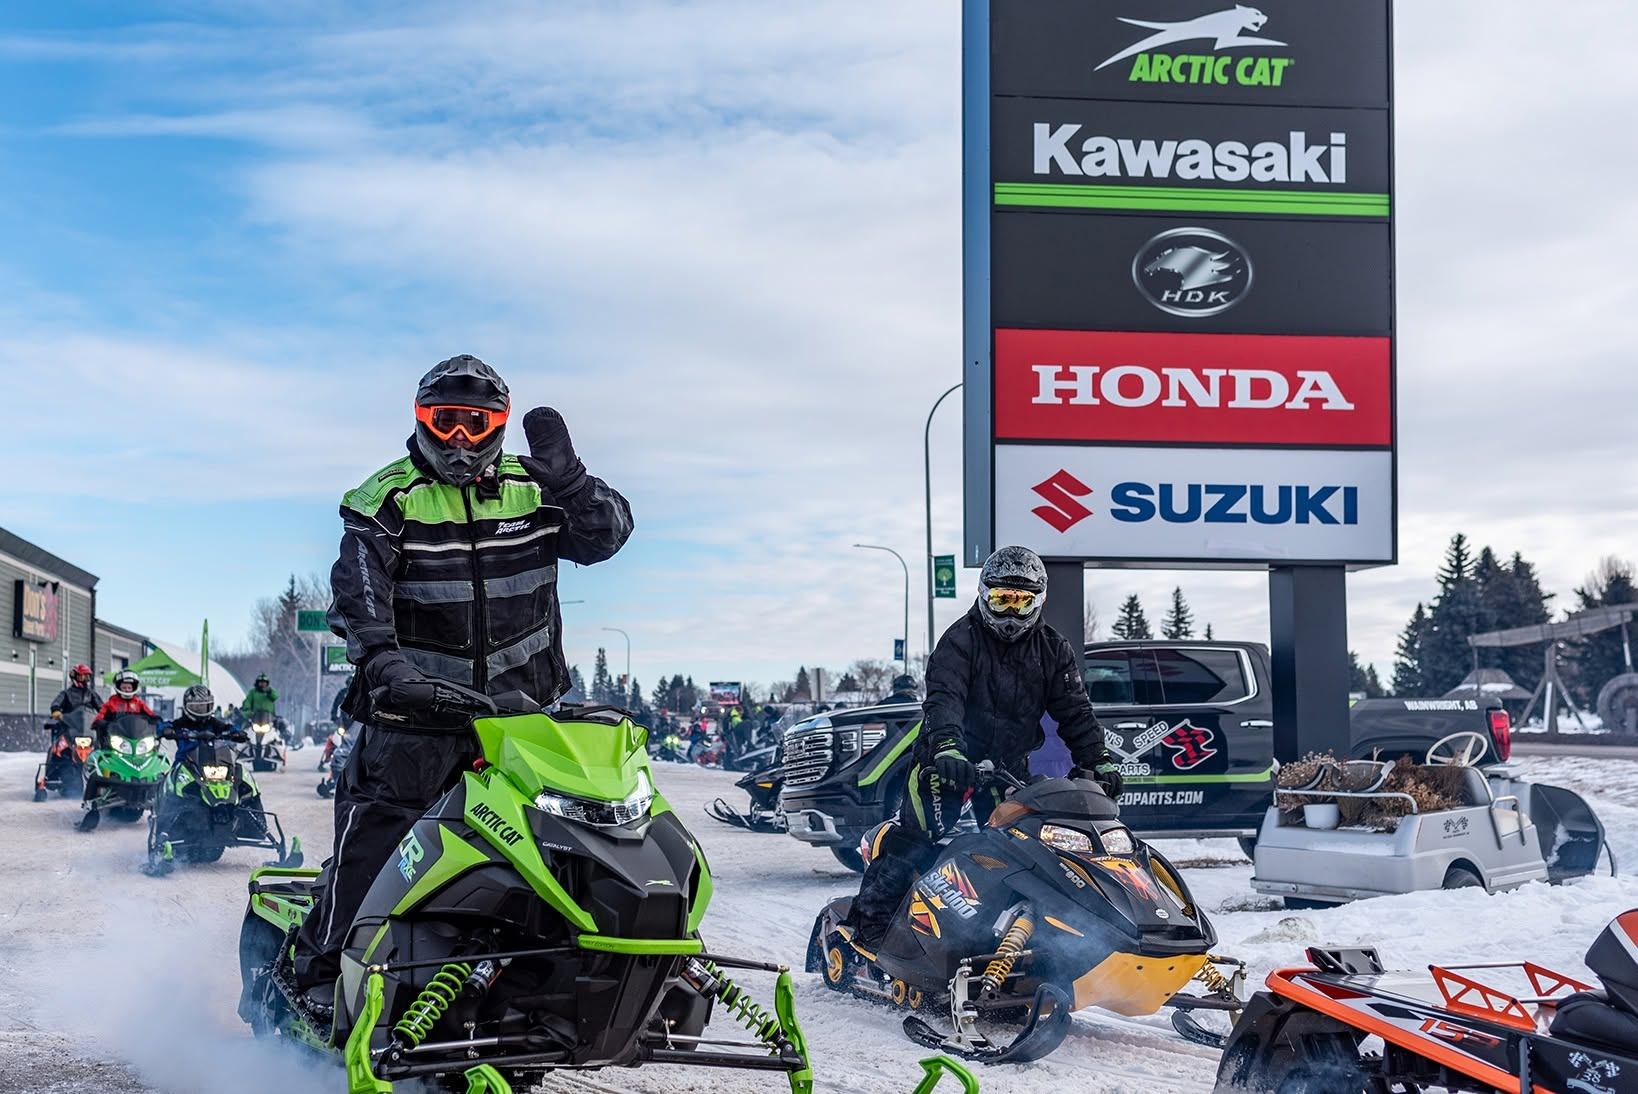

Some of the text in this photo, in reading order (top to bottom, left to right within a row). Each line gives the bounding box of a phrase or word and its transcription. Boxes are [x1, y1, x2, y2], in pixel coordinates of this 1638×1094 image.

[1128, 53, 1289, 86] ARCTIC CAT
[1033, 122, 1346, 183] Kawasaki
[1161, 289, 1230, 303] HDK
[1031, 364, 1355, 410] HONDA
[1110, 482, 1358, 525] SUZUKI
[1133, 721, 1169, 748] SPEED
[1118, 791, 1204, 805] EDPARTS.COM
[470, 802, 524, 846] ARCTIC CAT
[542, 841, 572, 851] CATALYST
